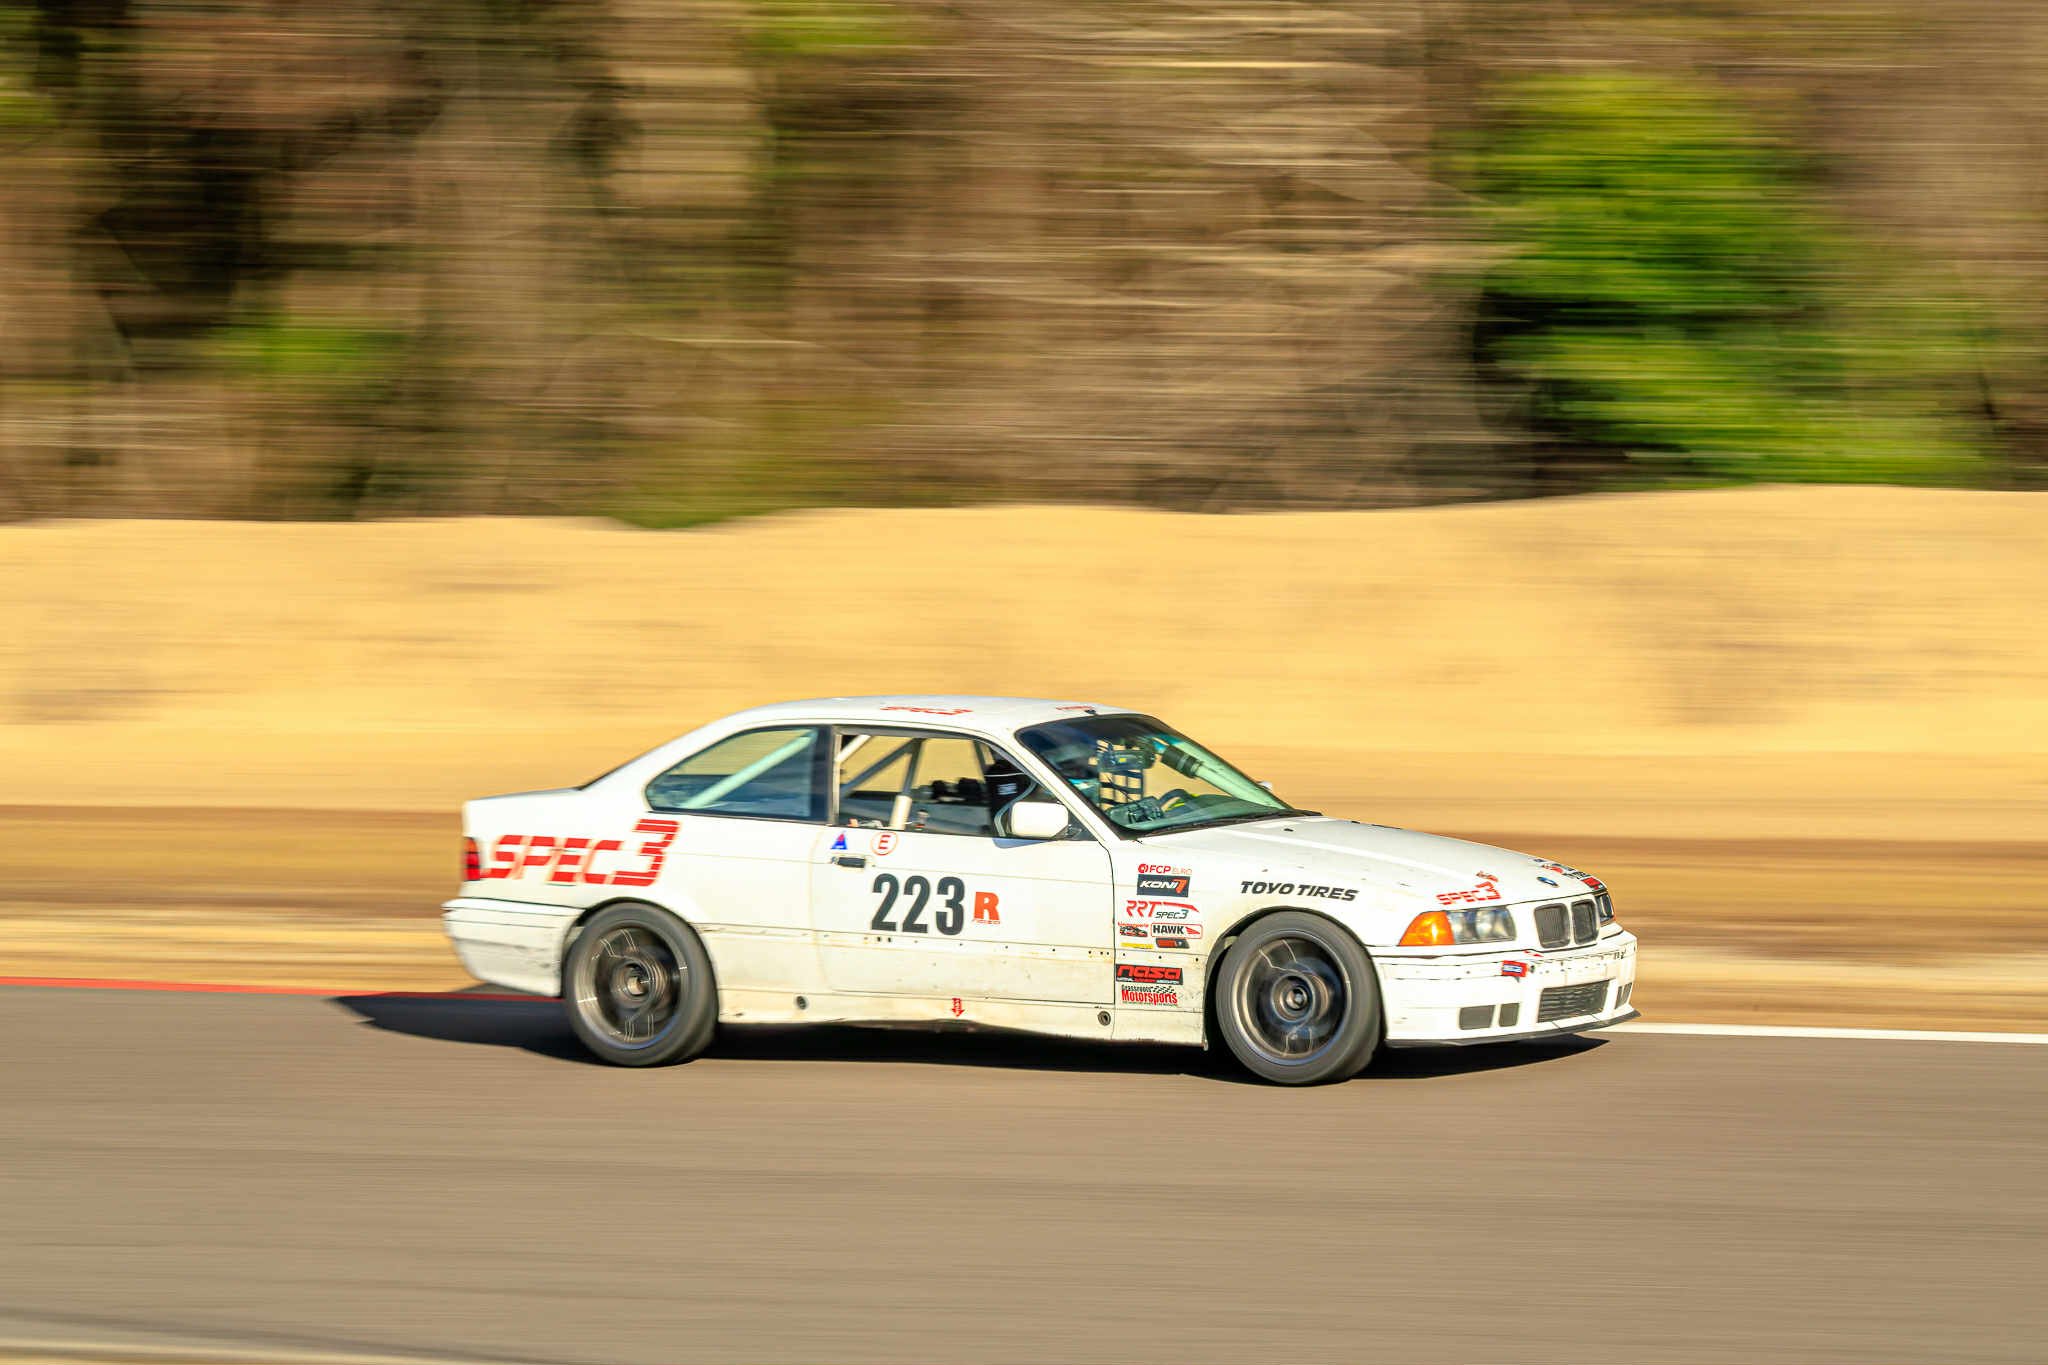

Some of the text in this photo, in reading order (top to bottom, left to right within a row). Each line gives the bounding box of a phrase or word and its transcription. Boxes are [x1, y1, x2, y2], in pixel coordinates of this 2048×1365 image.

[1149, 864, 1172, 874] FCP
[1140, 880, 1179, 889] KONI
[1240, 881, 1359, 902] TOYO TIRES
[871, 873, 965, 936] 223
[973, 891, 1000, 921] R
[1126, 900, 1162, 917] RRT
[1152, 924, 1184, 935] HAWK
[1121, 989, 1178, 1006] Motorsports
